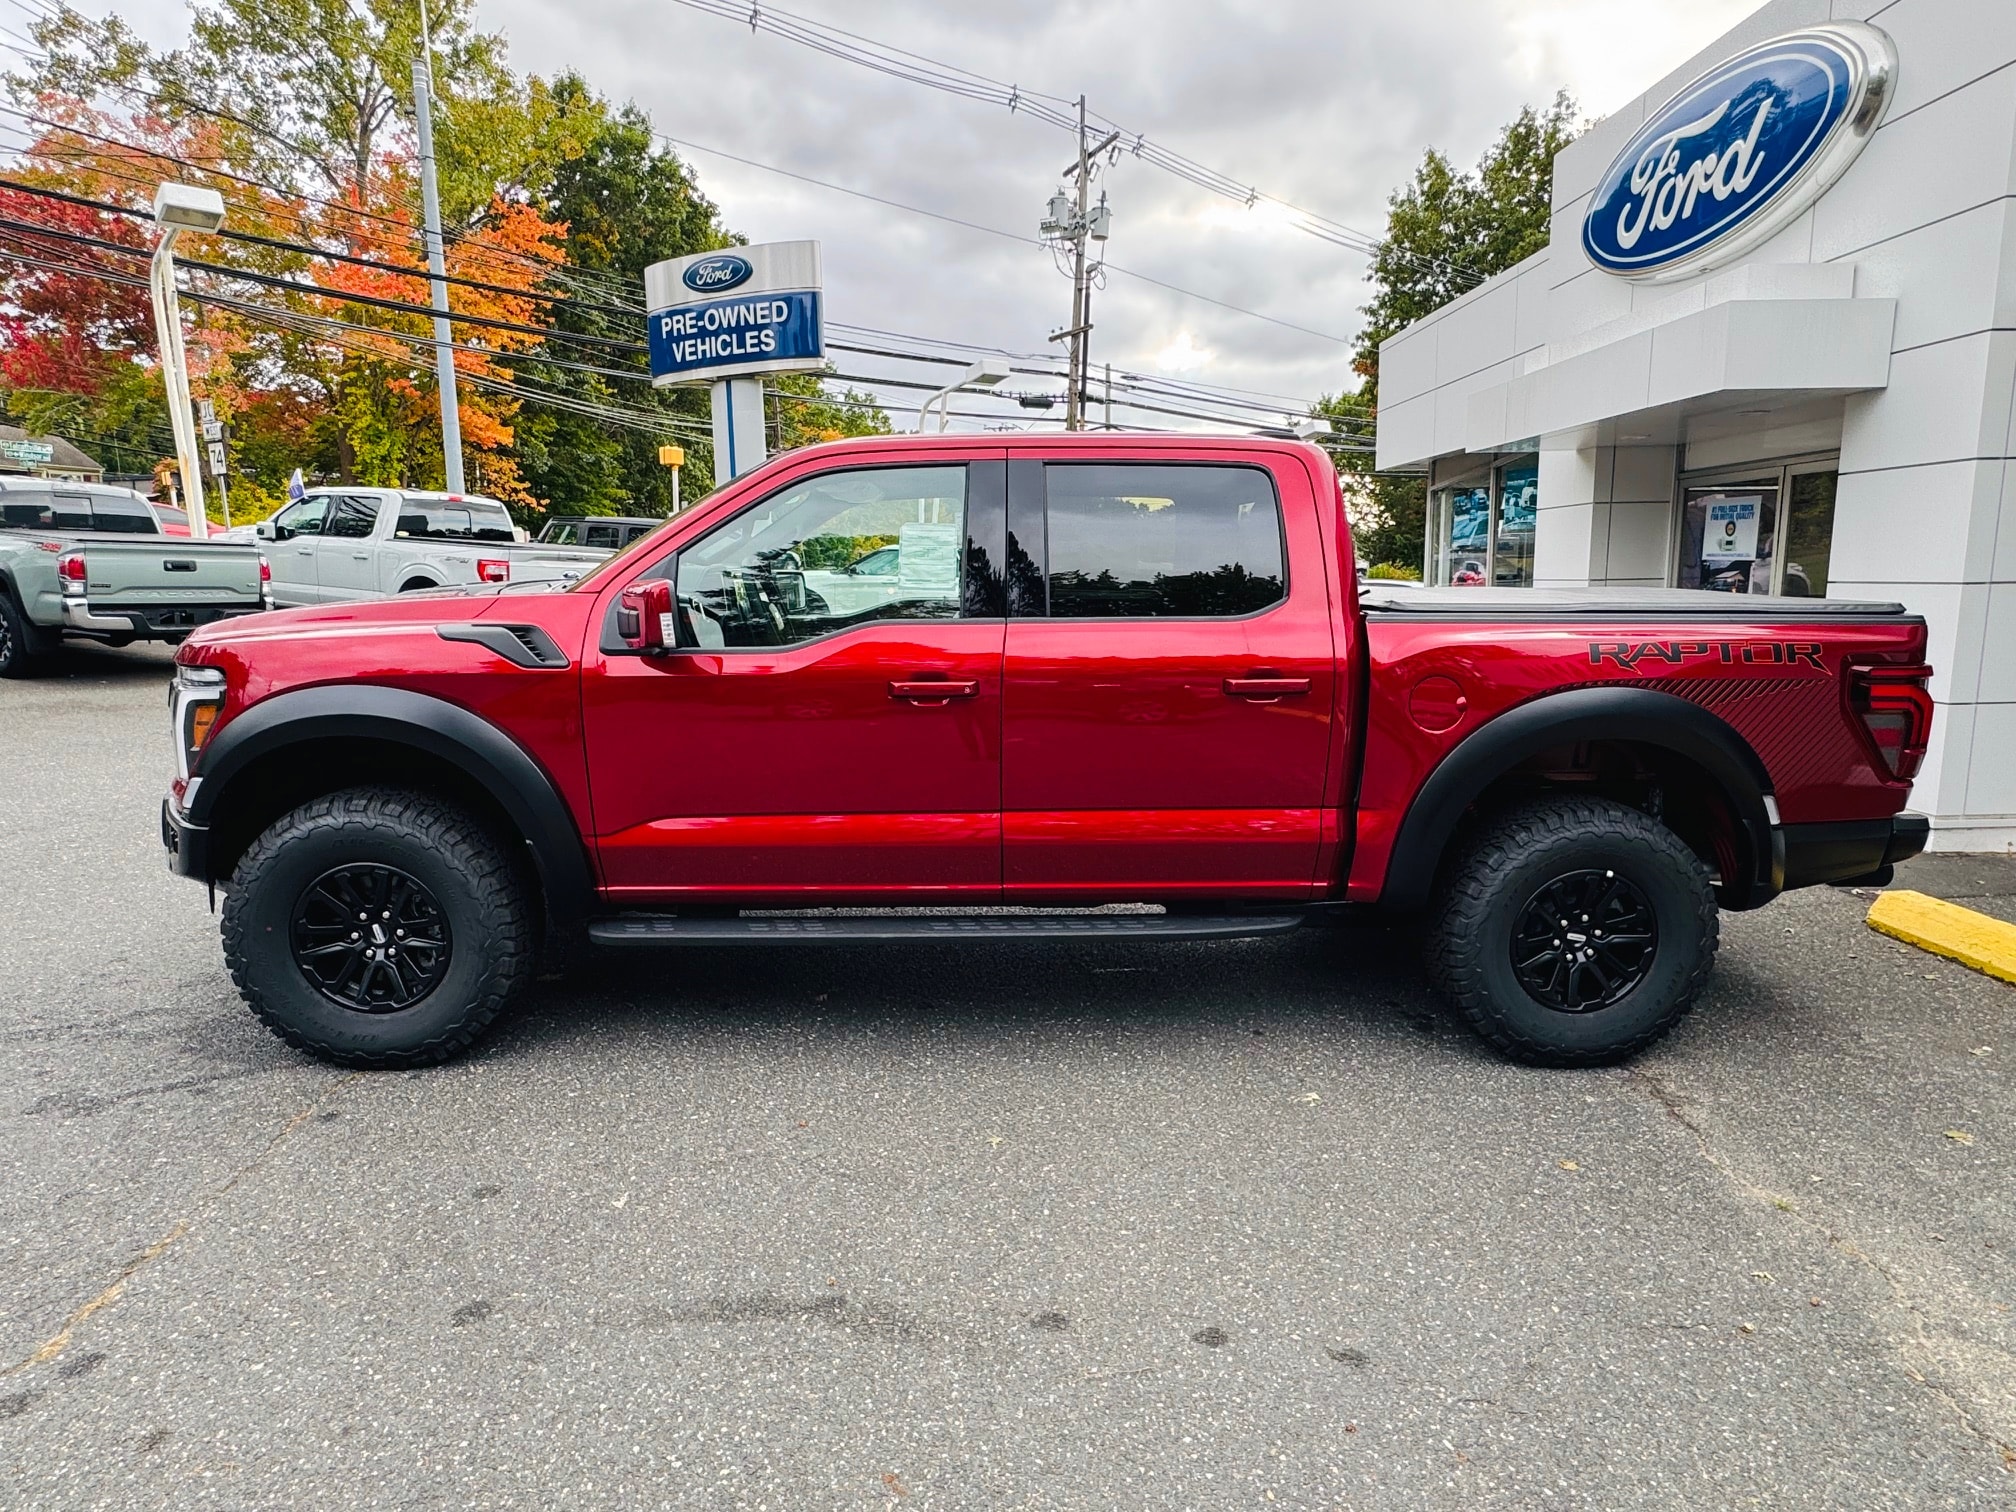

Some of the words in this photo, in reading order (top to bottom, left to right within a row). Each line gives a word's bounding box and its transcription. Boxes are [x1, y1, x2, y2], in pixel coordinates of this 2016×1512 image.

[1616, 94, 1776, 250] Ford
[696, 261, 734, 286] Ford
[661, 301, 788, 339] PRE-OWNED
[672, 329, 776, 363] VEHICLES
[210, 449, 224, 468] 74
[1587, 640, 1833, 677] RAPTOR
